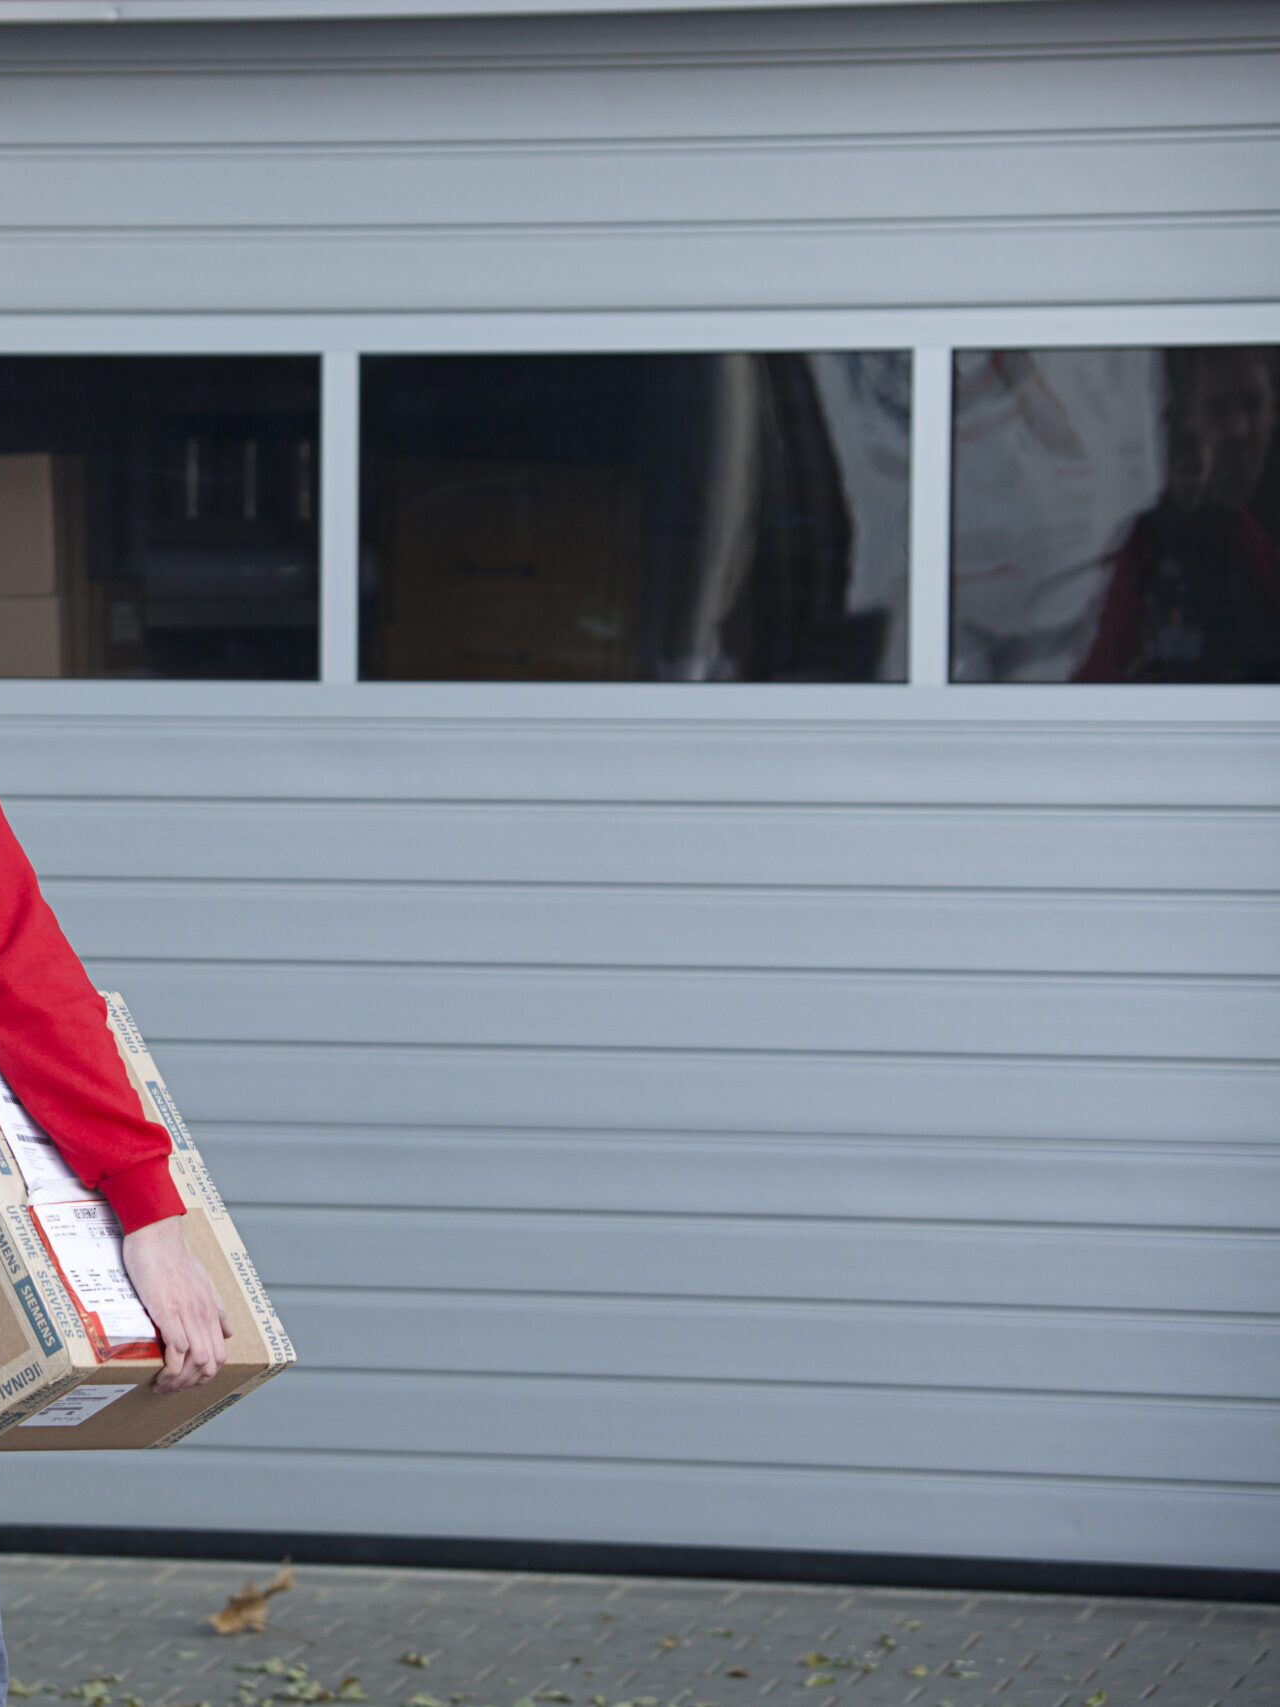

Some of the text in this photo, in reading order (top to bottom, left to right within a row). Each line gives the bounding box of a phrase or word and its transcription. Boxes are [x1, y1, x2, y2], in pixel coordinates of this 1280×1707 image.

[150, 1087, 183, 1146] SIEMENS
[188, 1156, 218, 1213] SIEMENS
[6, 1205, 39, 1259] UPTIME
[36, 1270, 74, 1339] SERVICES
[230, 1251, 265, 1315] PACKING
[20, 1284, 56, 1349] SIEMENS
